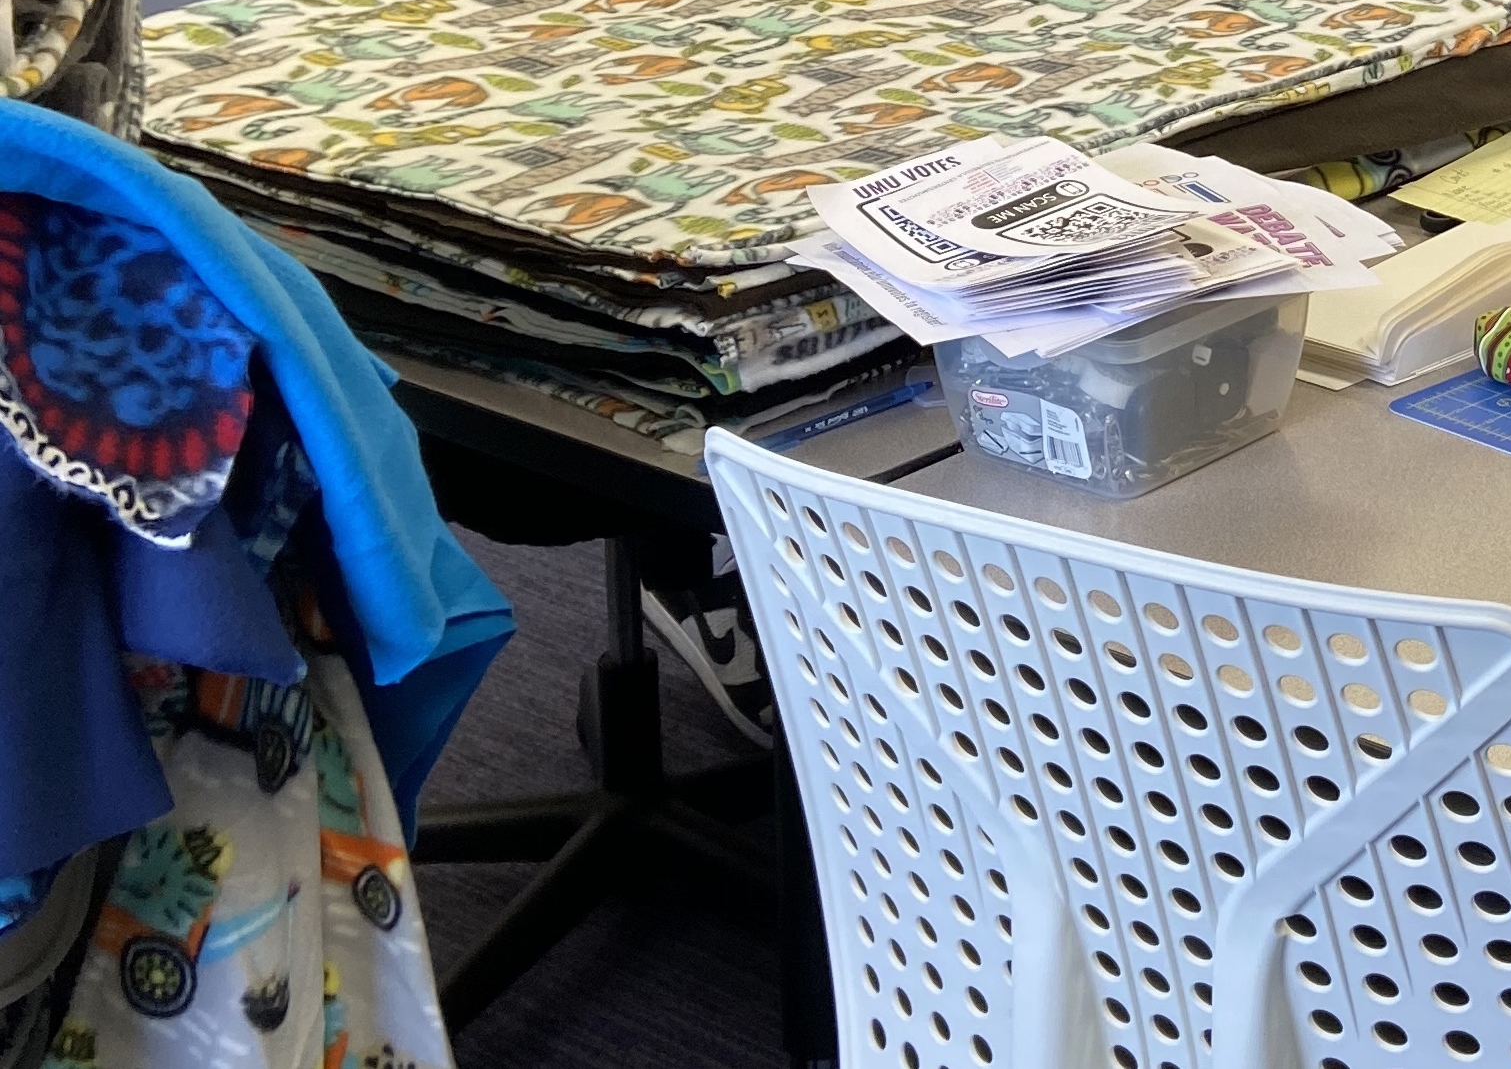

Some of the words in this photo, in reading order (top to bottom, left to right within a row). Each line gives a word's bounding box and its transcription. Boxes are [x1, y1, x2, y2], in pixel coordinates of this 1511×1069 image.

[852, 174, 902, 200] UMU
[900, 156, 962, 182] VOTES
[986, 209, 1017, 225] ME
[1013, 192, 1057, 214] SCAN
[1236, 203, 1334, 268] DEBATE
